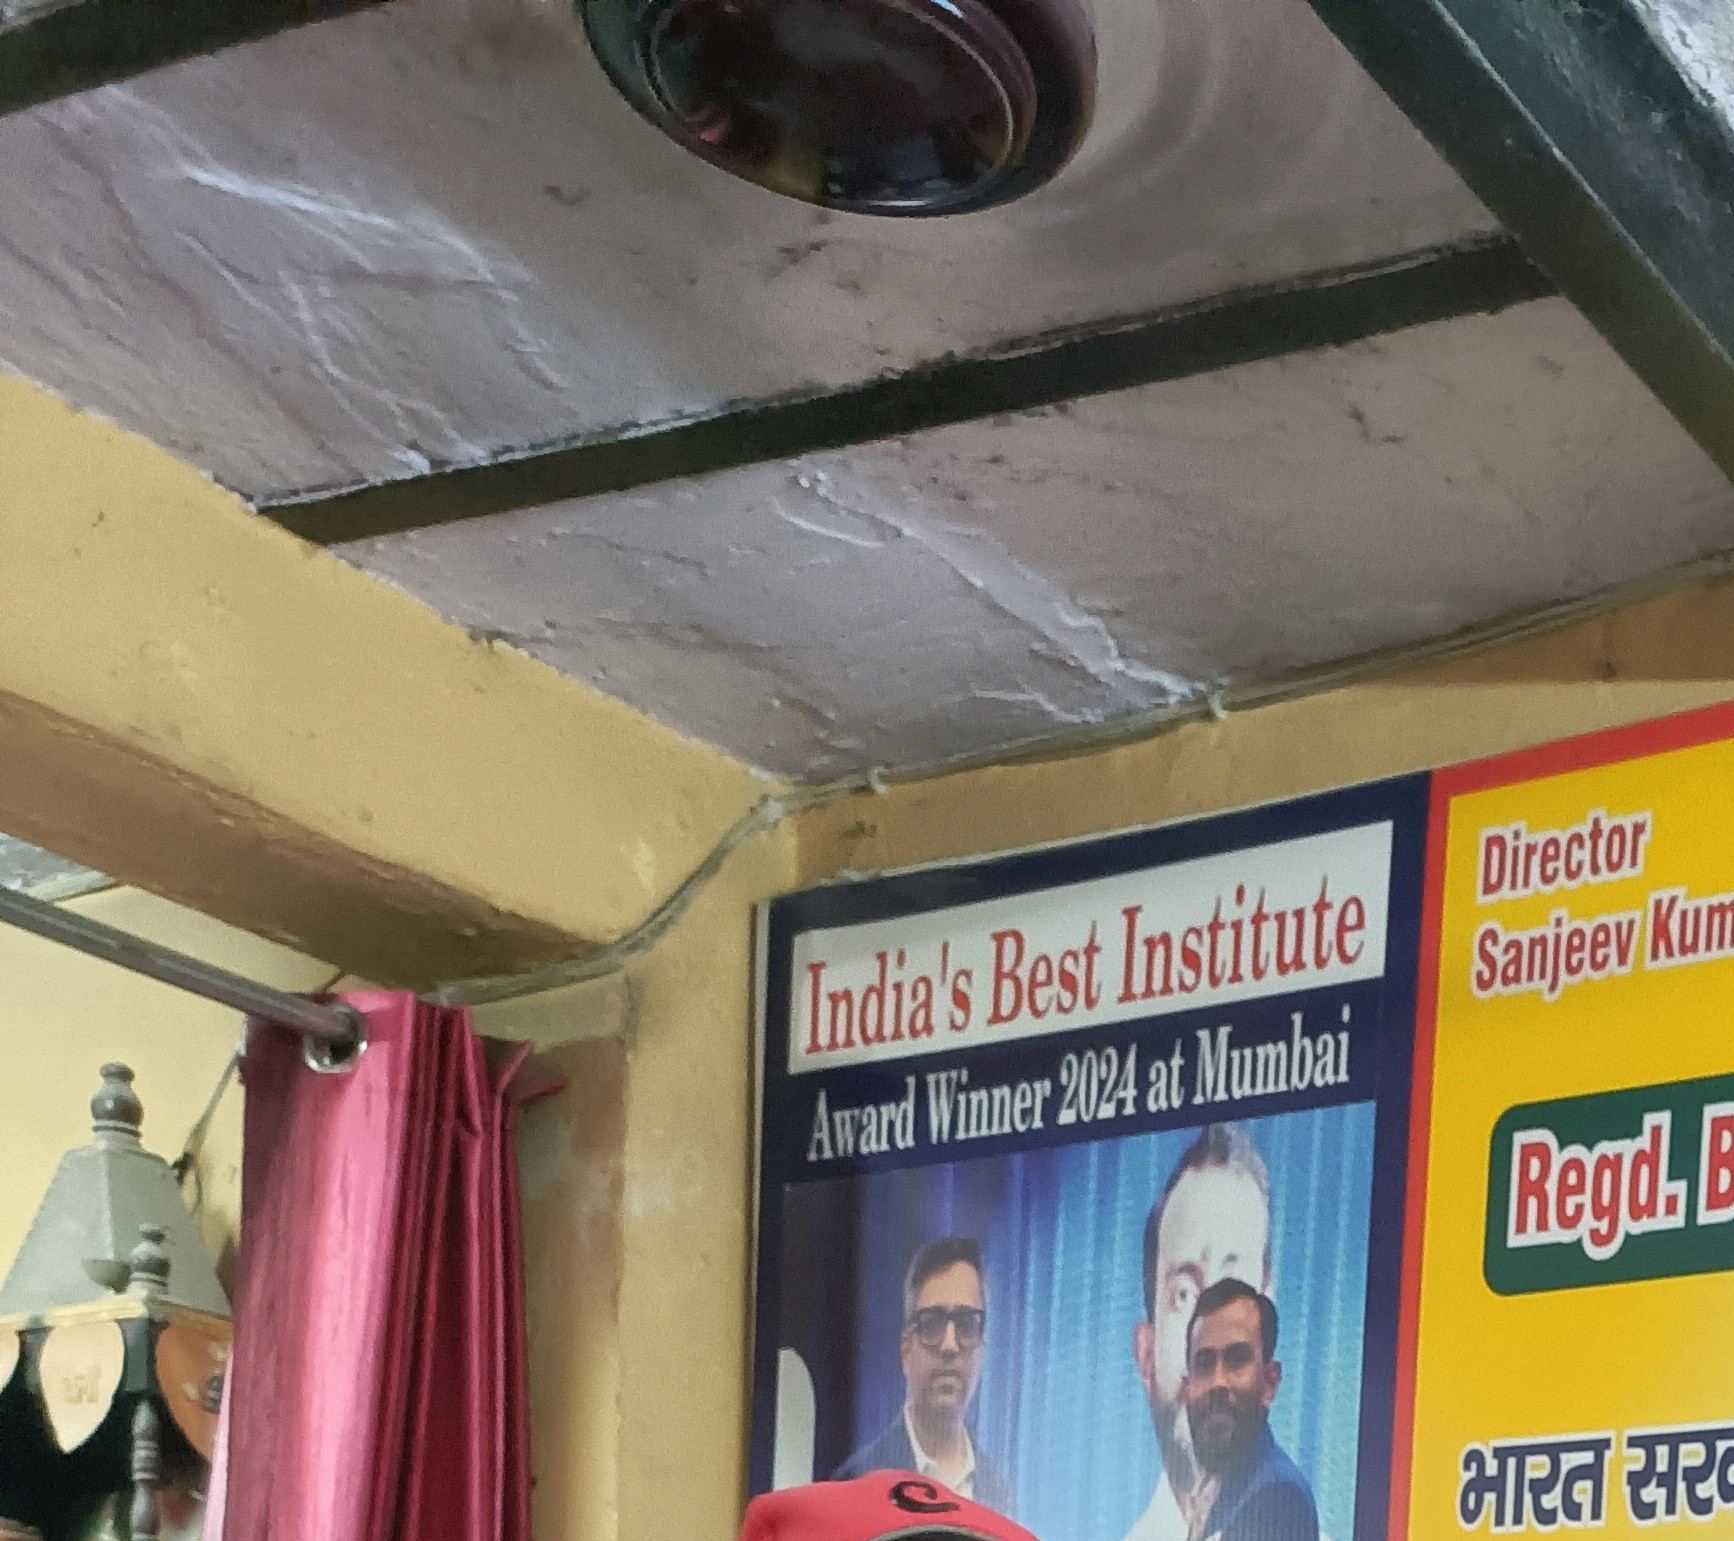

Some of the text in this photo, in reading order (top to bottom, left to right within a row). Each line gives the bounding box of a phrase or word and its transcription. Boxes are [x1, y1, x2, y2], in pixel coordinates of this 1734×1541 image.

[1481, 815, 1648, 895] Director
[805, 876, 1366, 1055] India's Best Institute
[1476, 917, 1634, 997] Sanjeev
[808, 1004, 1350, 1161] Award Winner 2024 at Mumbai
[1513, 1122, 1679, 1251] Regd.
[1460, 1434, 1611, 1528] भारत
